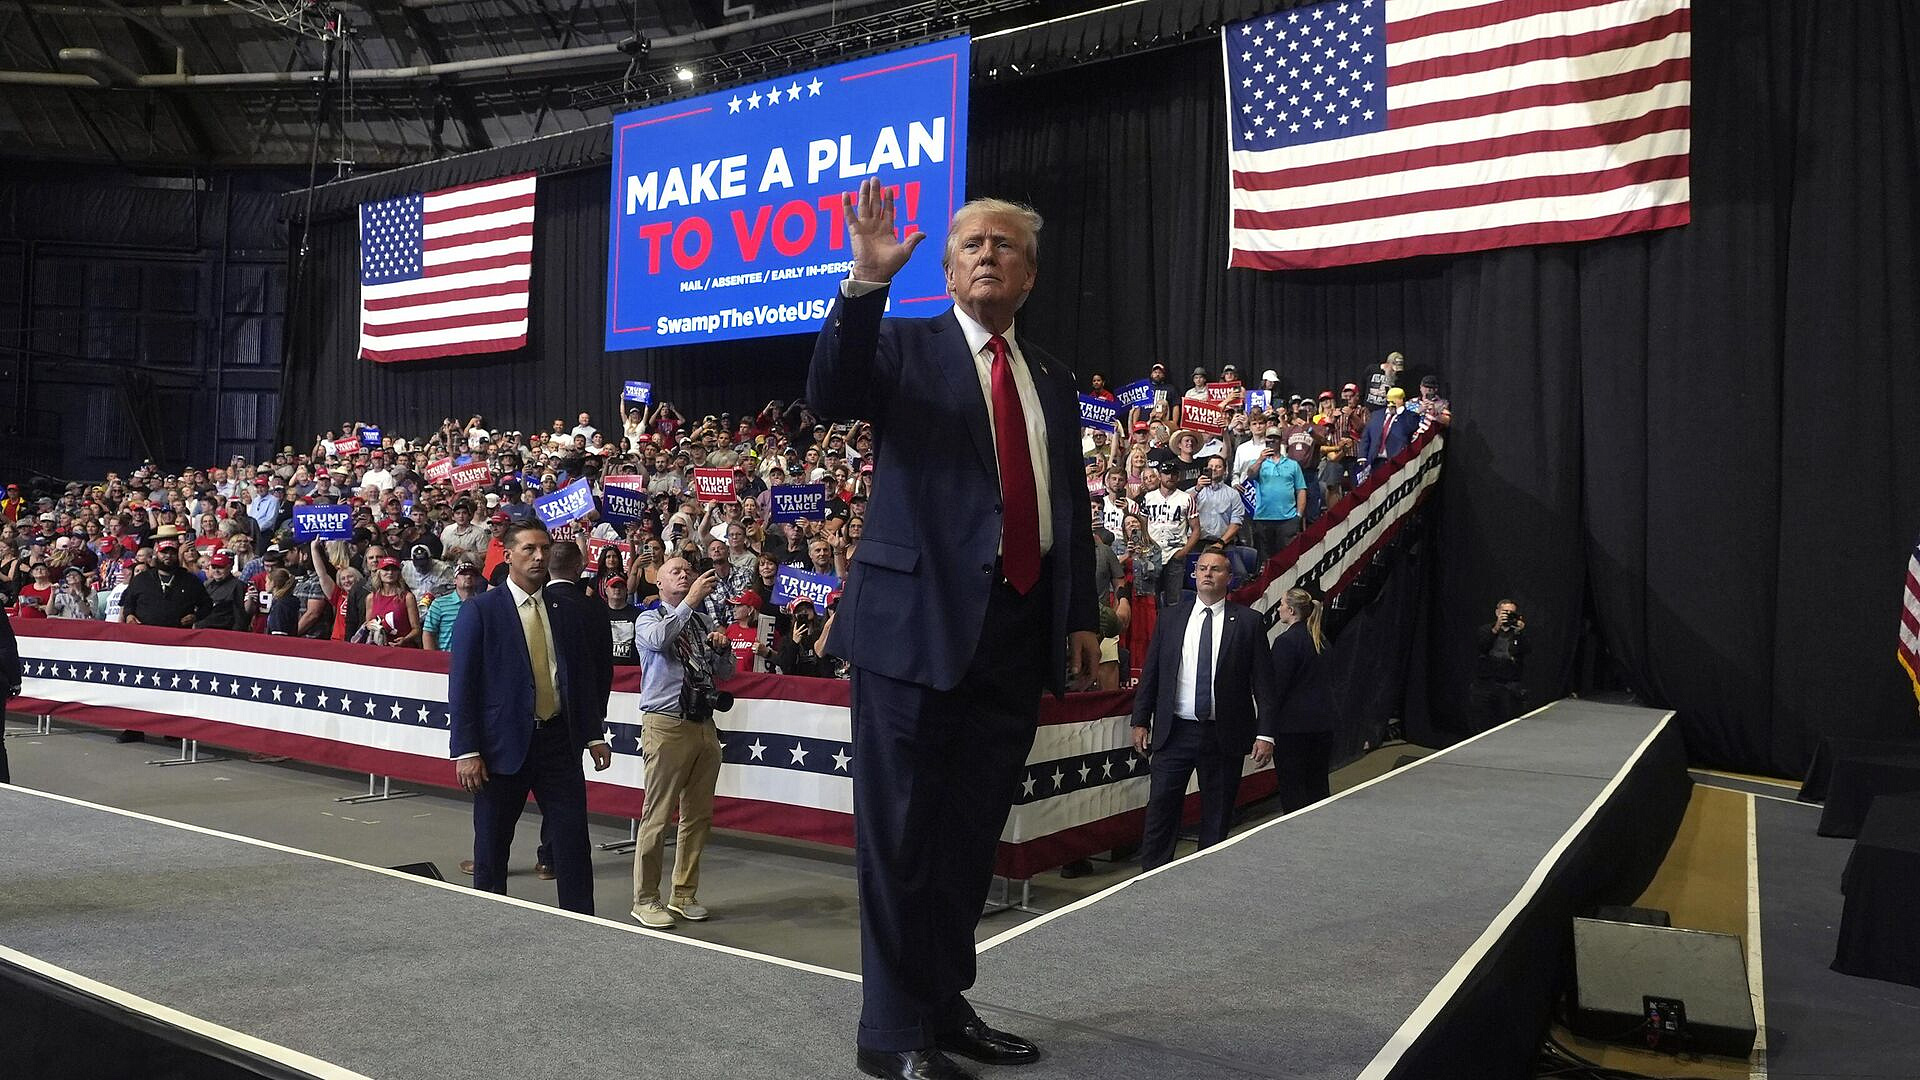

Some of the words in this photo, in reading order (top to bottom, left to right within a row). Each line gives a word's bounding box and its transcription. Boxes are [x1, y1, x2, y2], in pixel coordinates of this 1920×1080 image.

[626, 154, 747, 214] MAKE
[758, 147, 794, 193] A
[807, 116, 946, 184] PLAN
[639, 216, 713, 275] TO
[680, 281, 703, 293] MAIL
[711, 272, 763, 289] ABSENTEE
[771, 265, 804, 281] EARLY
[806, 260, 856, 277] IN-PERSO
[1117, 385, 1149, 401] TRUMP
[1208, 387, 1235, 395] TRUM
[1120, 392, 1147, 405] VANCE
[1079, 402, 1116, 417] TRUMP
[1185, 405, 1221, 418] TRUMP
[1081, 410, 1111, 422] VANCE
[1188, 413, 1217, 425] VANCE
[452, 467, 488, 479] TRUMP
[457, 474, 485, 485] VANCE
[696, 476, 732, 486] TRUMP
[700, 484, 729, 493] VANCE
[540, 488, 587, 513] TRUMP
[607, 495, 645, 510] TRUMP
[774, 493, 822, 504] TRUMP
[547, 498, 585, 517] VANCE
[612, 504, 642, 516] VANCE
[781, 502, 817, 512] VANCE
[296, 513, 349, 524] TRUMP
[303, 521, 343, 530] VANCE
[552, 533, 576, 541] VANC
[780, 574, 832, 595] TRUMP
[784, 585, 825, 603] VANCE
